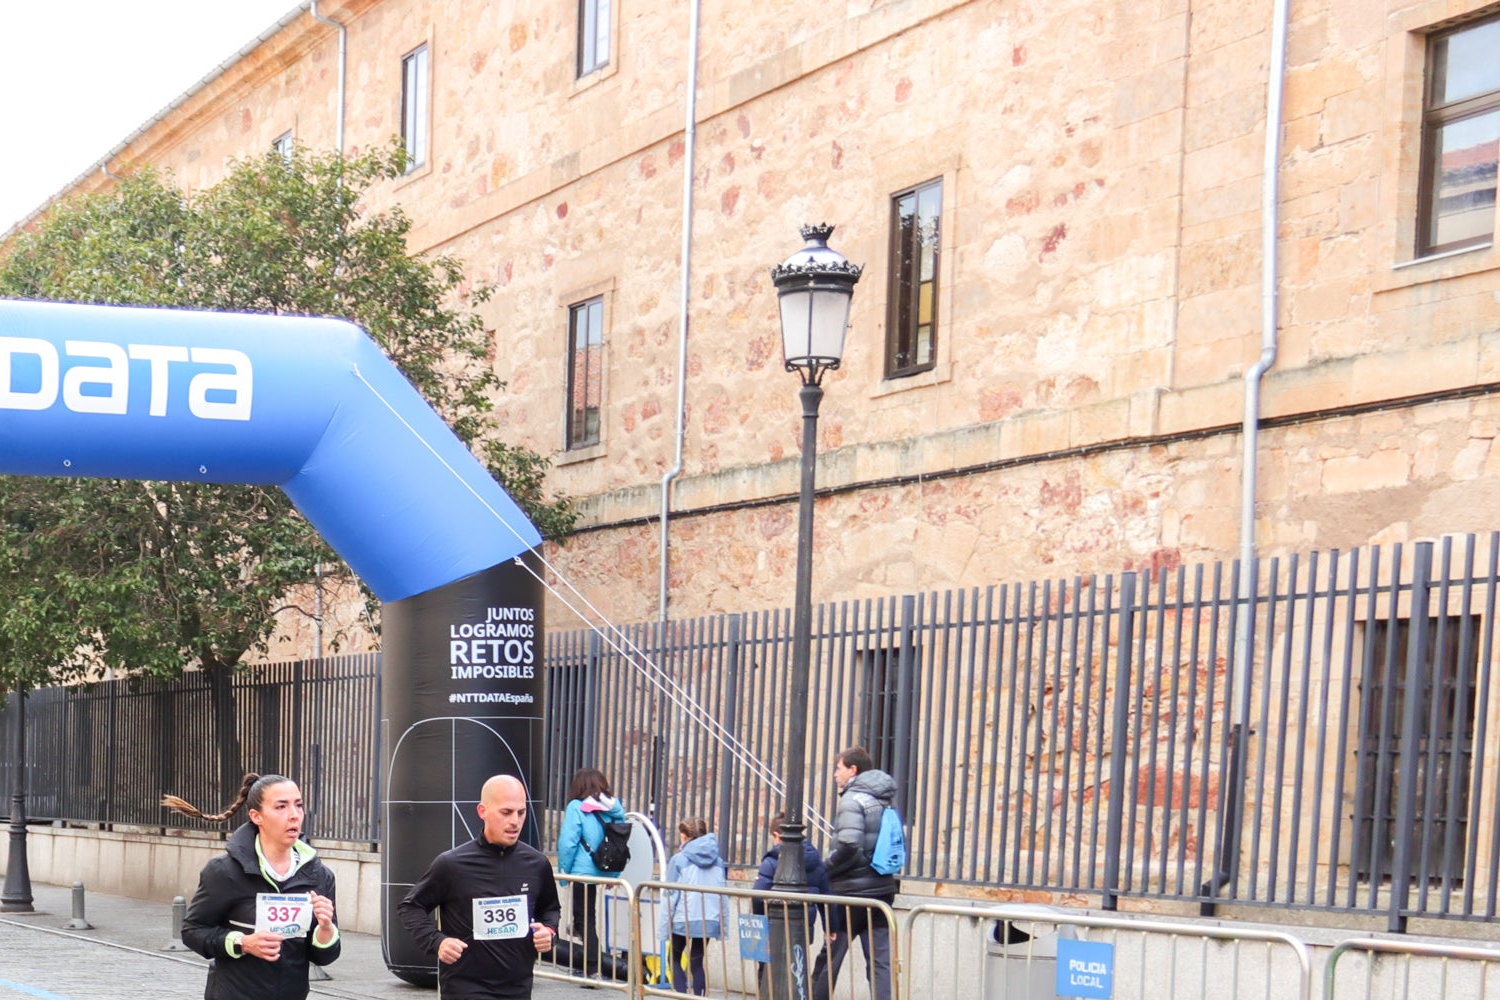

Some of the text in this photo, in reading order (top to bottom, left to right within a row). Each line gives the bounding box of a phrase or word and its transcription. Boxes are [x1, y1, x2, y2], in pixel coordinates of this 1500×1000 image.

[485, 607, 534, 623] JUNTOS
[450, 623, 534, 639] LOGRAMOS
[450, 639, 534, 664] RETOS
[451, 665, 534, 679] IMPOSIBLES
[449, 692, 533, 705] #NTTDATAEspaña
[268, 906, 301, 922] 337
[484, 908, 516, 923] 336
[487, 926, 515, 935] HESAN
[1069, 959, 1107, 975] POLICIA
[1070, 974, 1103, 988] LOCAL
